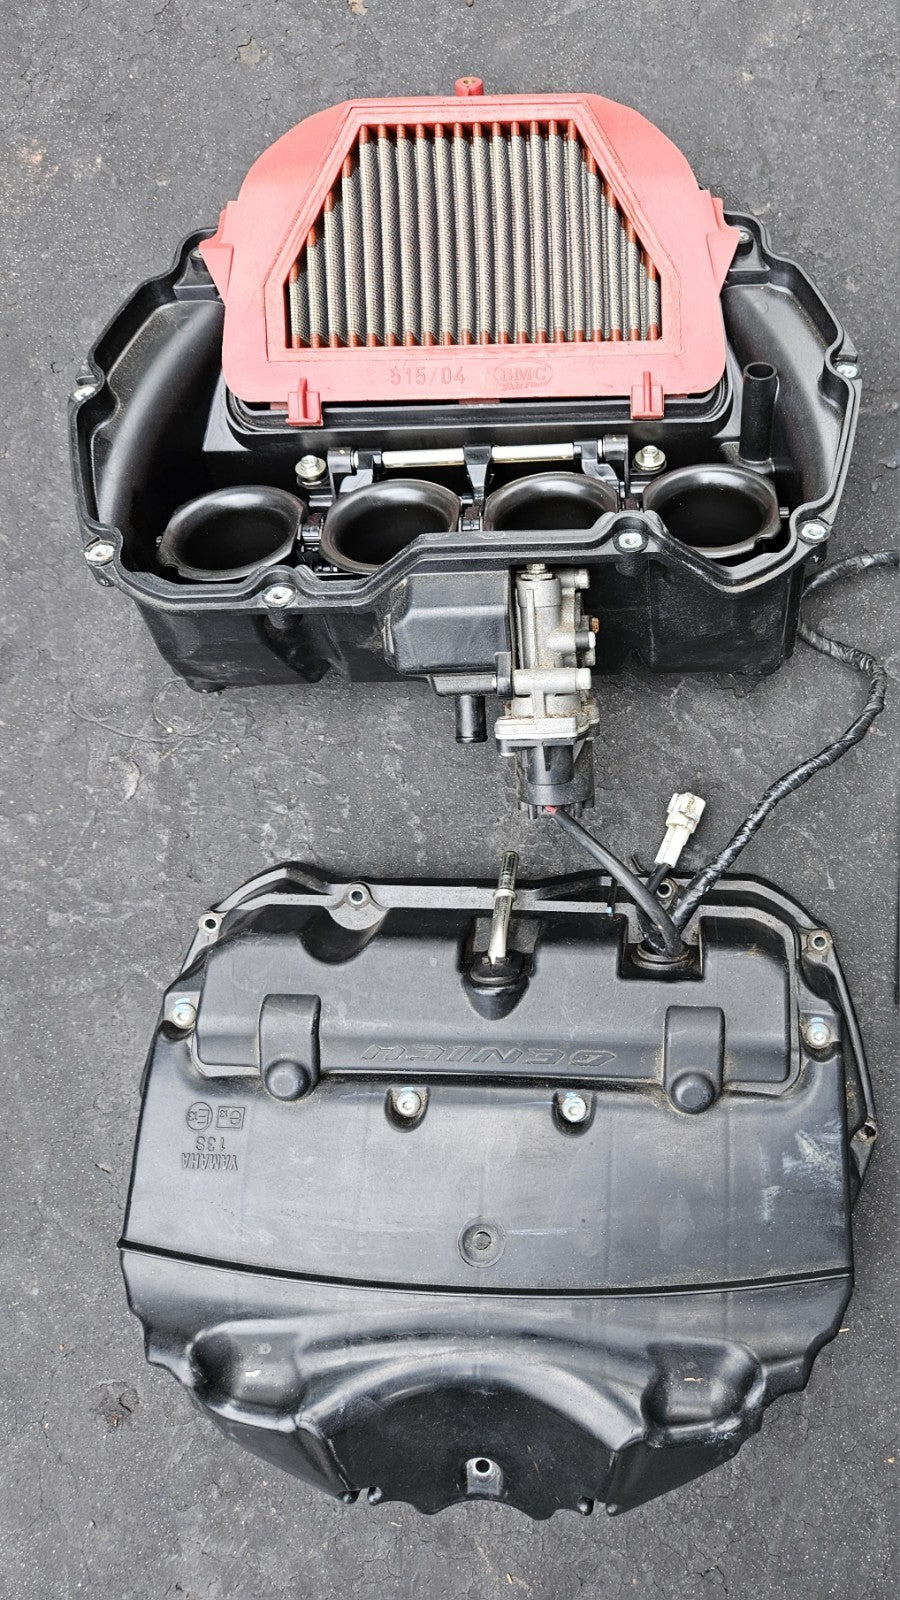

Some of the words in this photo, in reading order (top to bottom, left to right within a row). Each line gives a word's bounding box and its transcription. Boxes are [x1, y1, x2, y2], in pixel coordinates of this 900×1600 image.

[390, 366, 465, 385] 515/04
[501, 367, 547, 381] BMC
[361, 1044, 616, 1067] GENICH
[195, 1135, 226, 1152] 13S
[181, 1152, 238, 1171] YAMAHA
